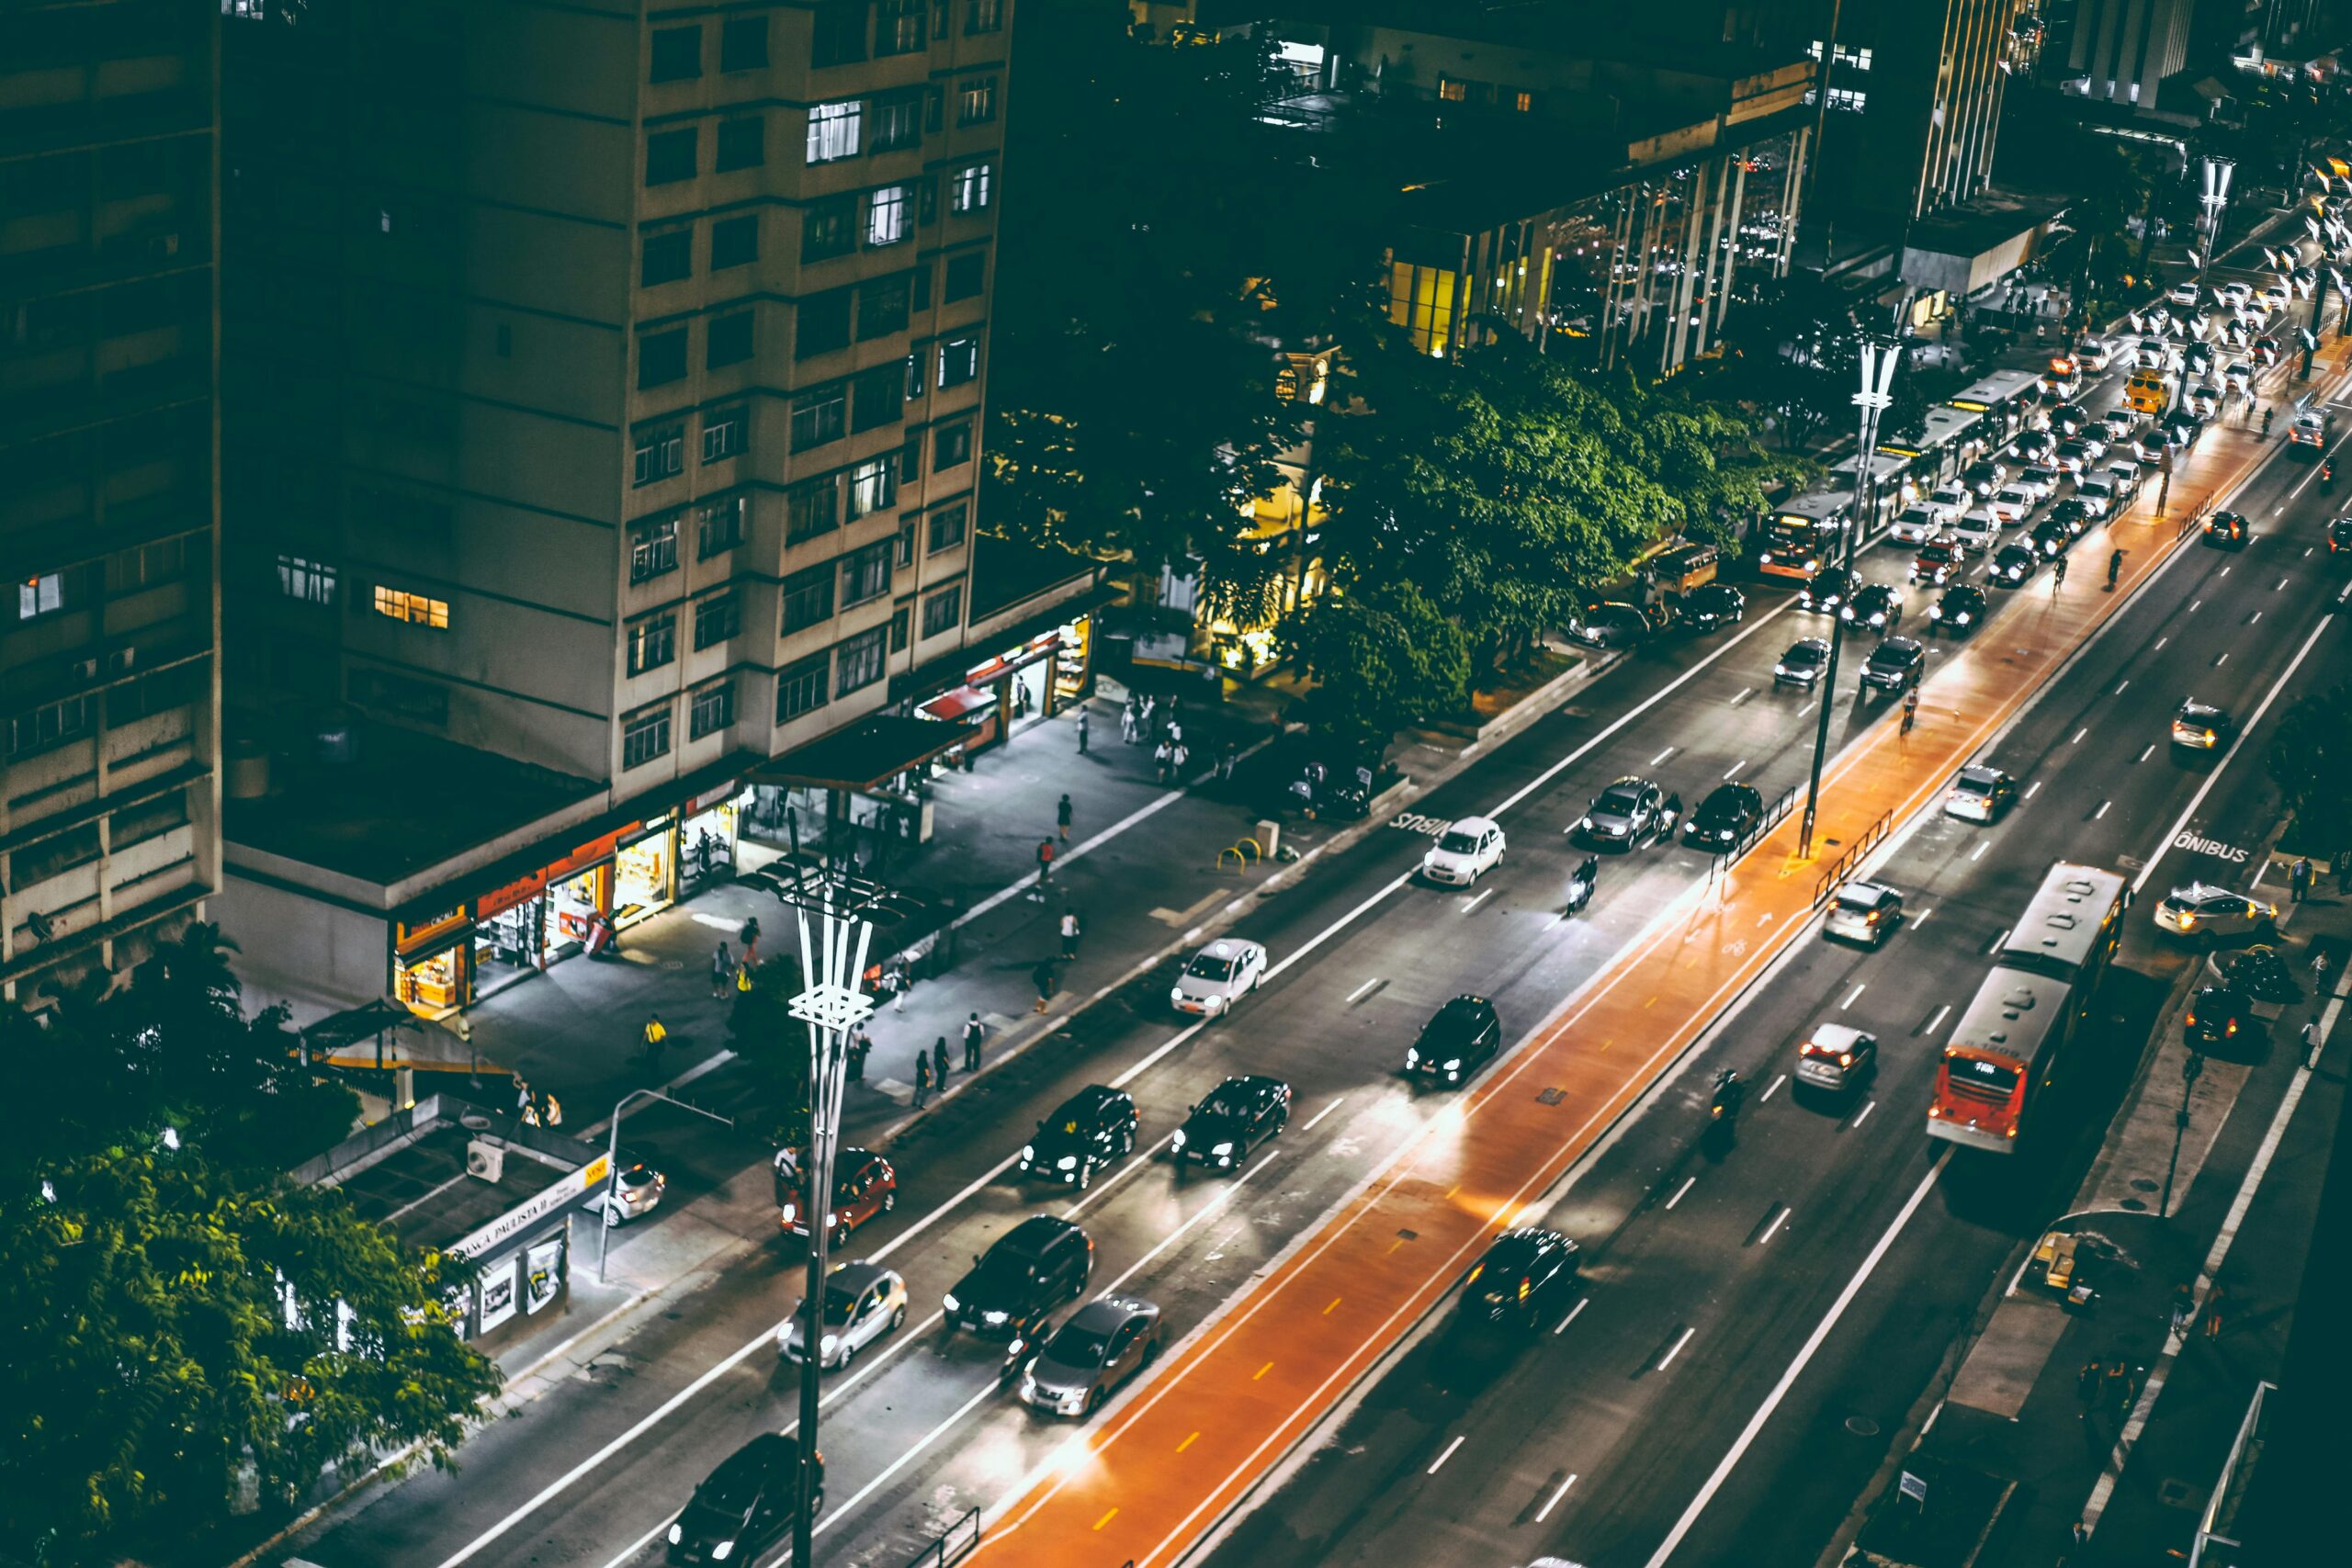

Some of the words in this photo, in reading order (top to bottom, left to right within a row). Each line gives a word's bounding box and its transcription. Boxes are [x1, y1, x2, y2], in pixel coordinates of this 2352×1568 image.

[1389, 813, 1453, 838] NIBUS
[2174, 831, 2249, 863] ÔNIBUS
[465, 1233, 492, 1256] ANCA
[494, 1205, 537, 1239] PAULISTA
